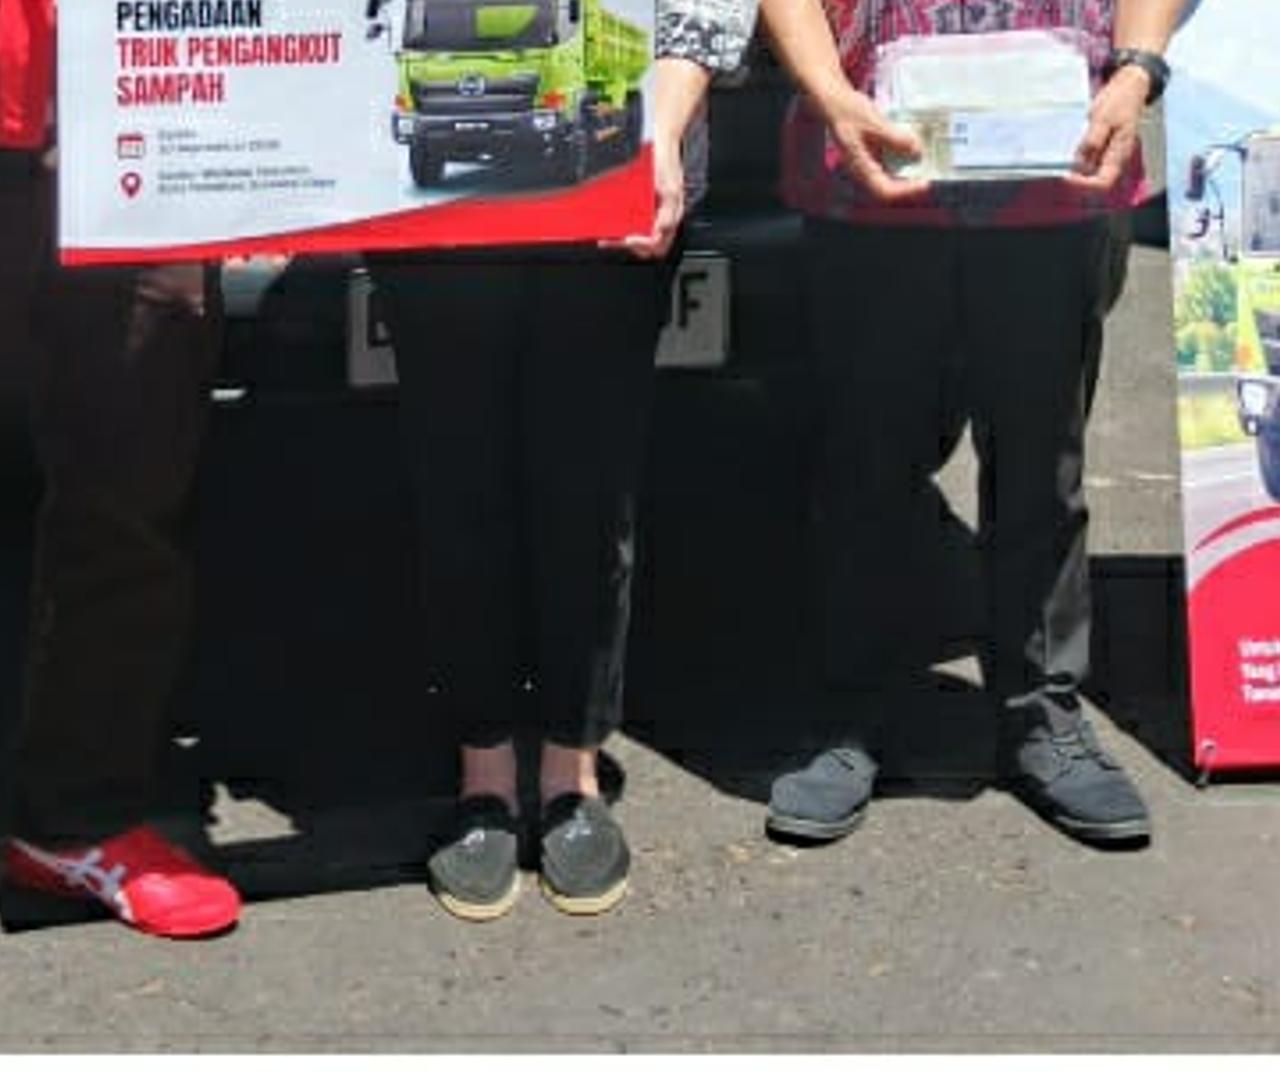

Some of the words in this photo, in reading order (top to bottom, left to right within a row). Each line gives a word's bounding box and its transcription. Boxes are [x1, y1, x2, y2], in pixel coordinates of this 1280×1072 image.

[117, 34, 178, 69] TRUK
[186, 32, 343, 66] PENGANGKUT
[116, 73, 225, 107] SAMPAH
